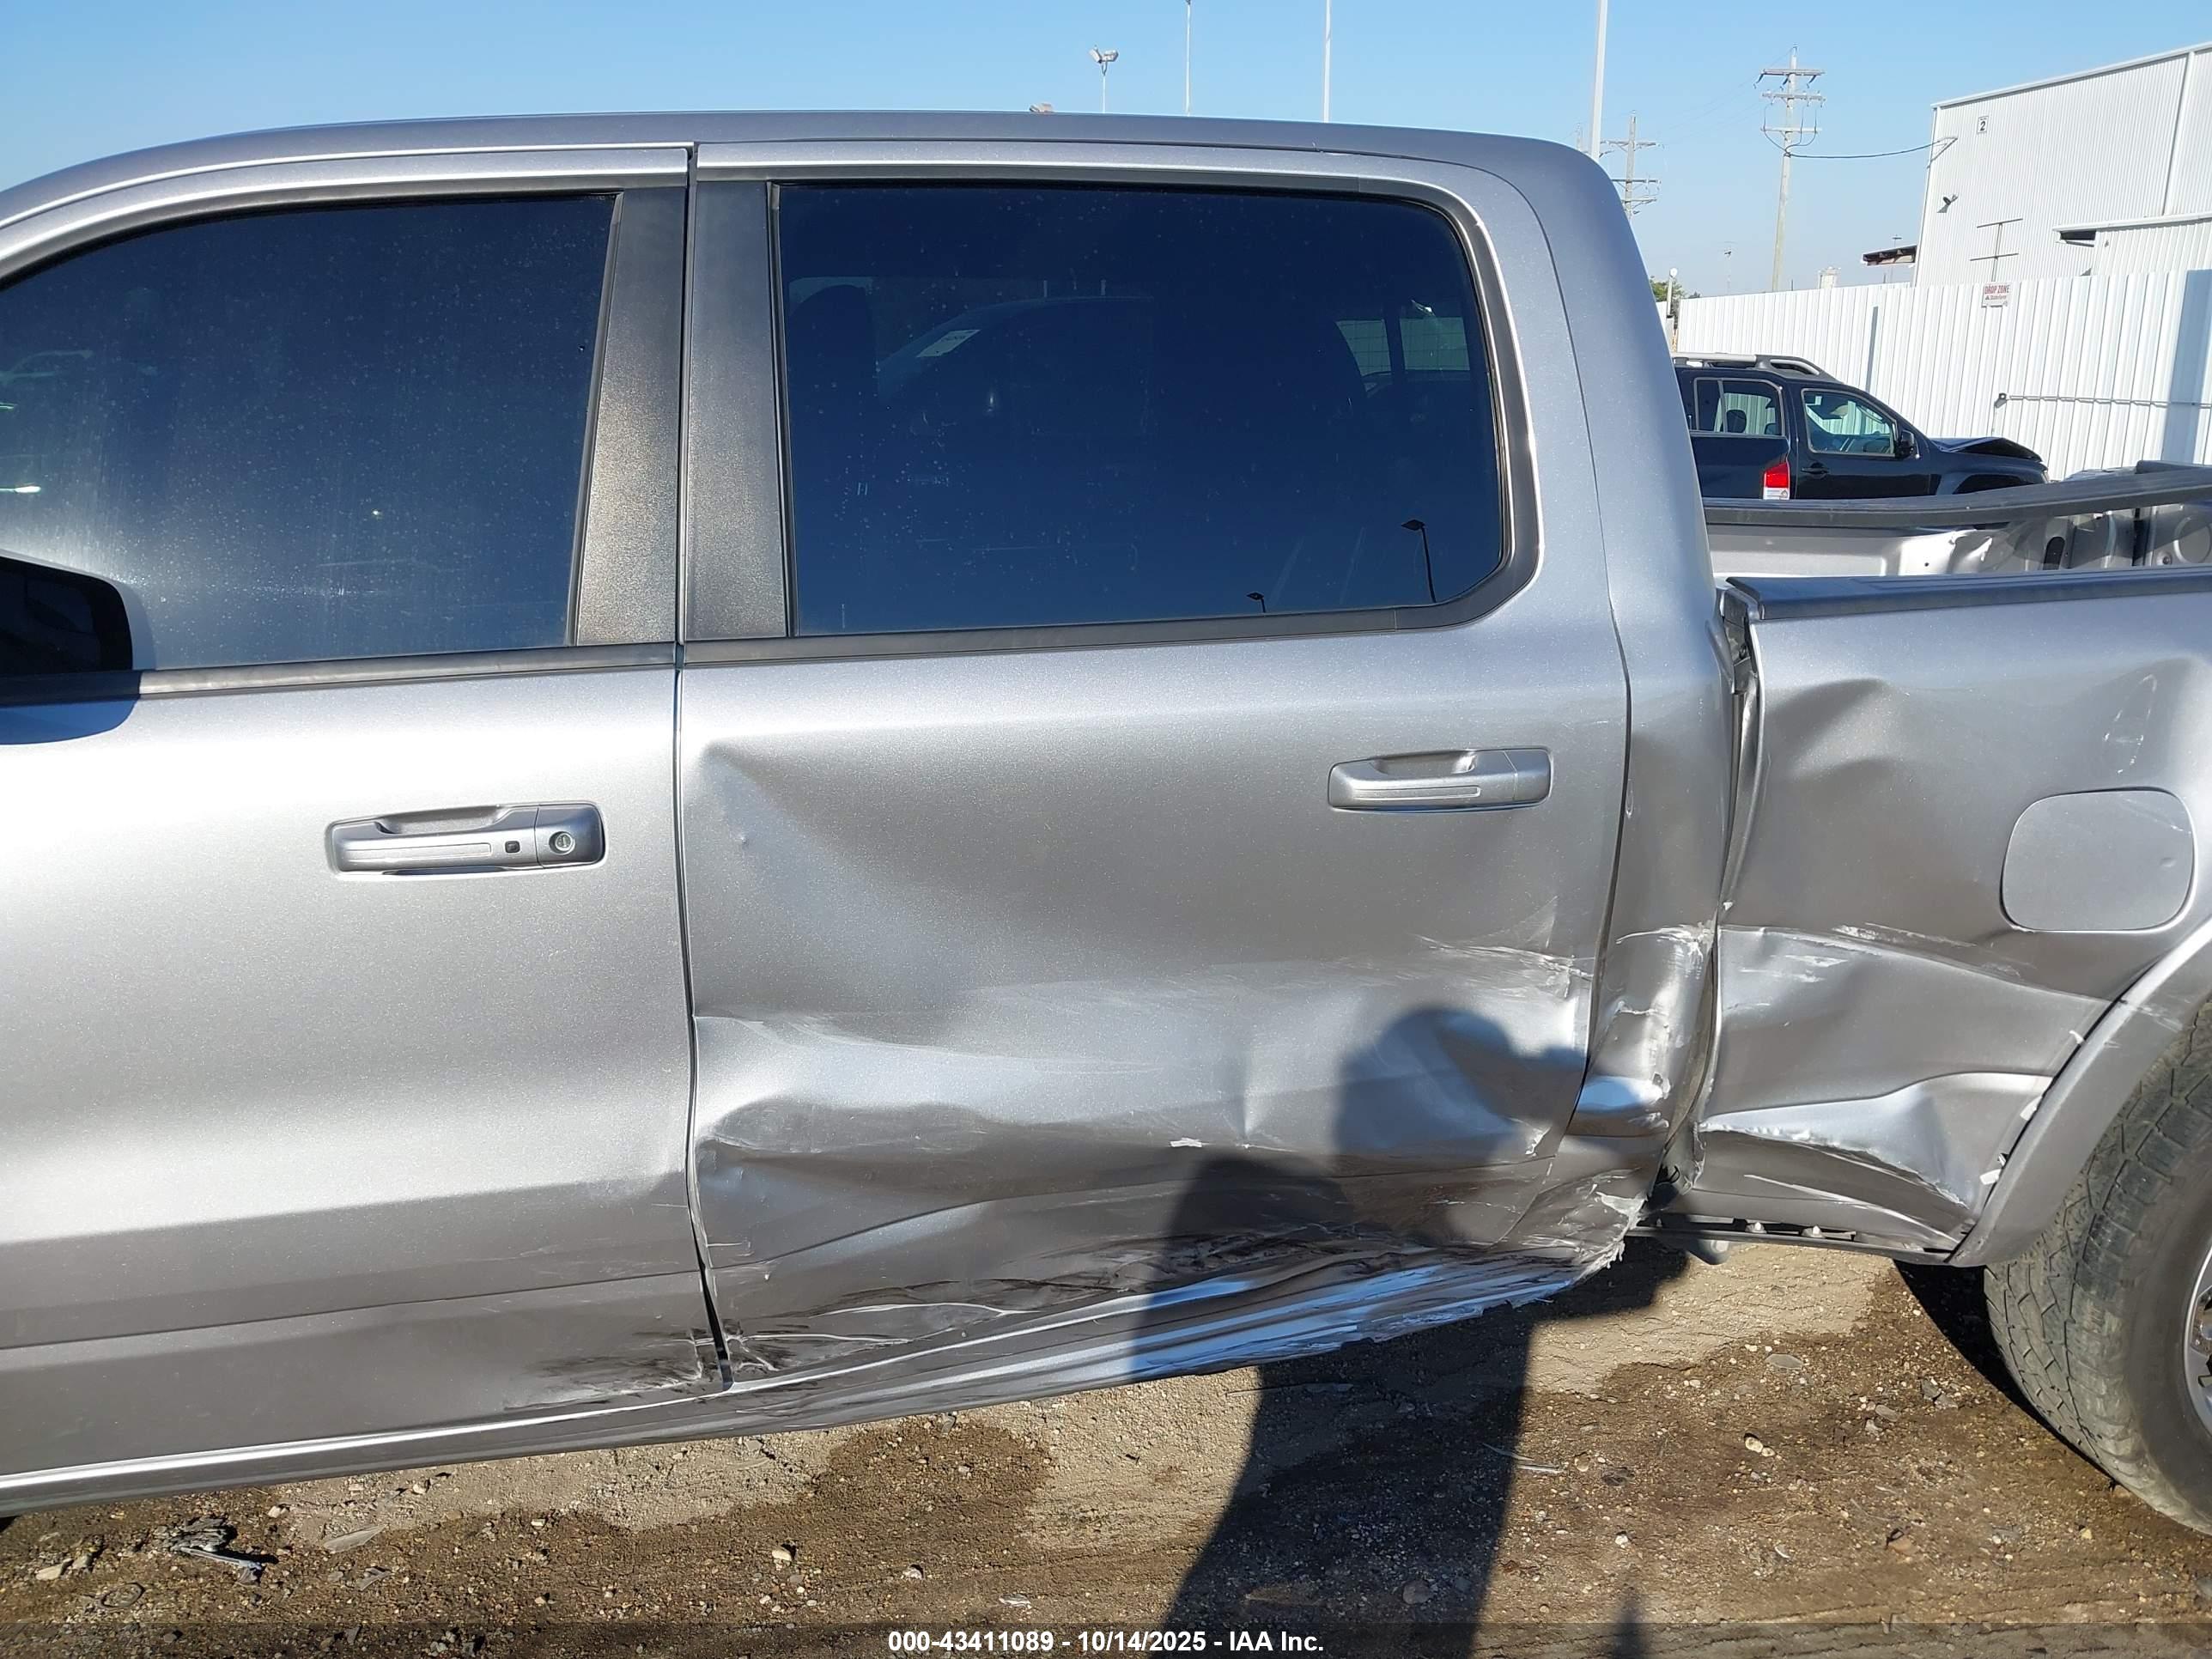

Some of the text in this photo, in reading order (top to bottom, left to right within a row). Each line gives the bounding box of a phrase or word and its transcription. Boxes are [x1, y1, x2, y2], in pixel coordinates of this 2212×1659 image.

[1980, 120, 1986, 131] 2
[1984, 284, 2010, 295] DROP ZONE
